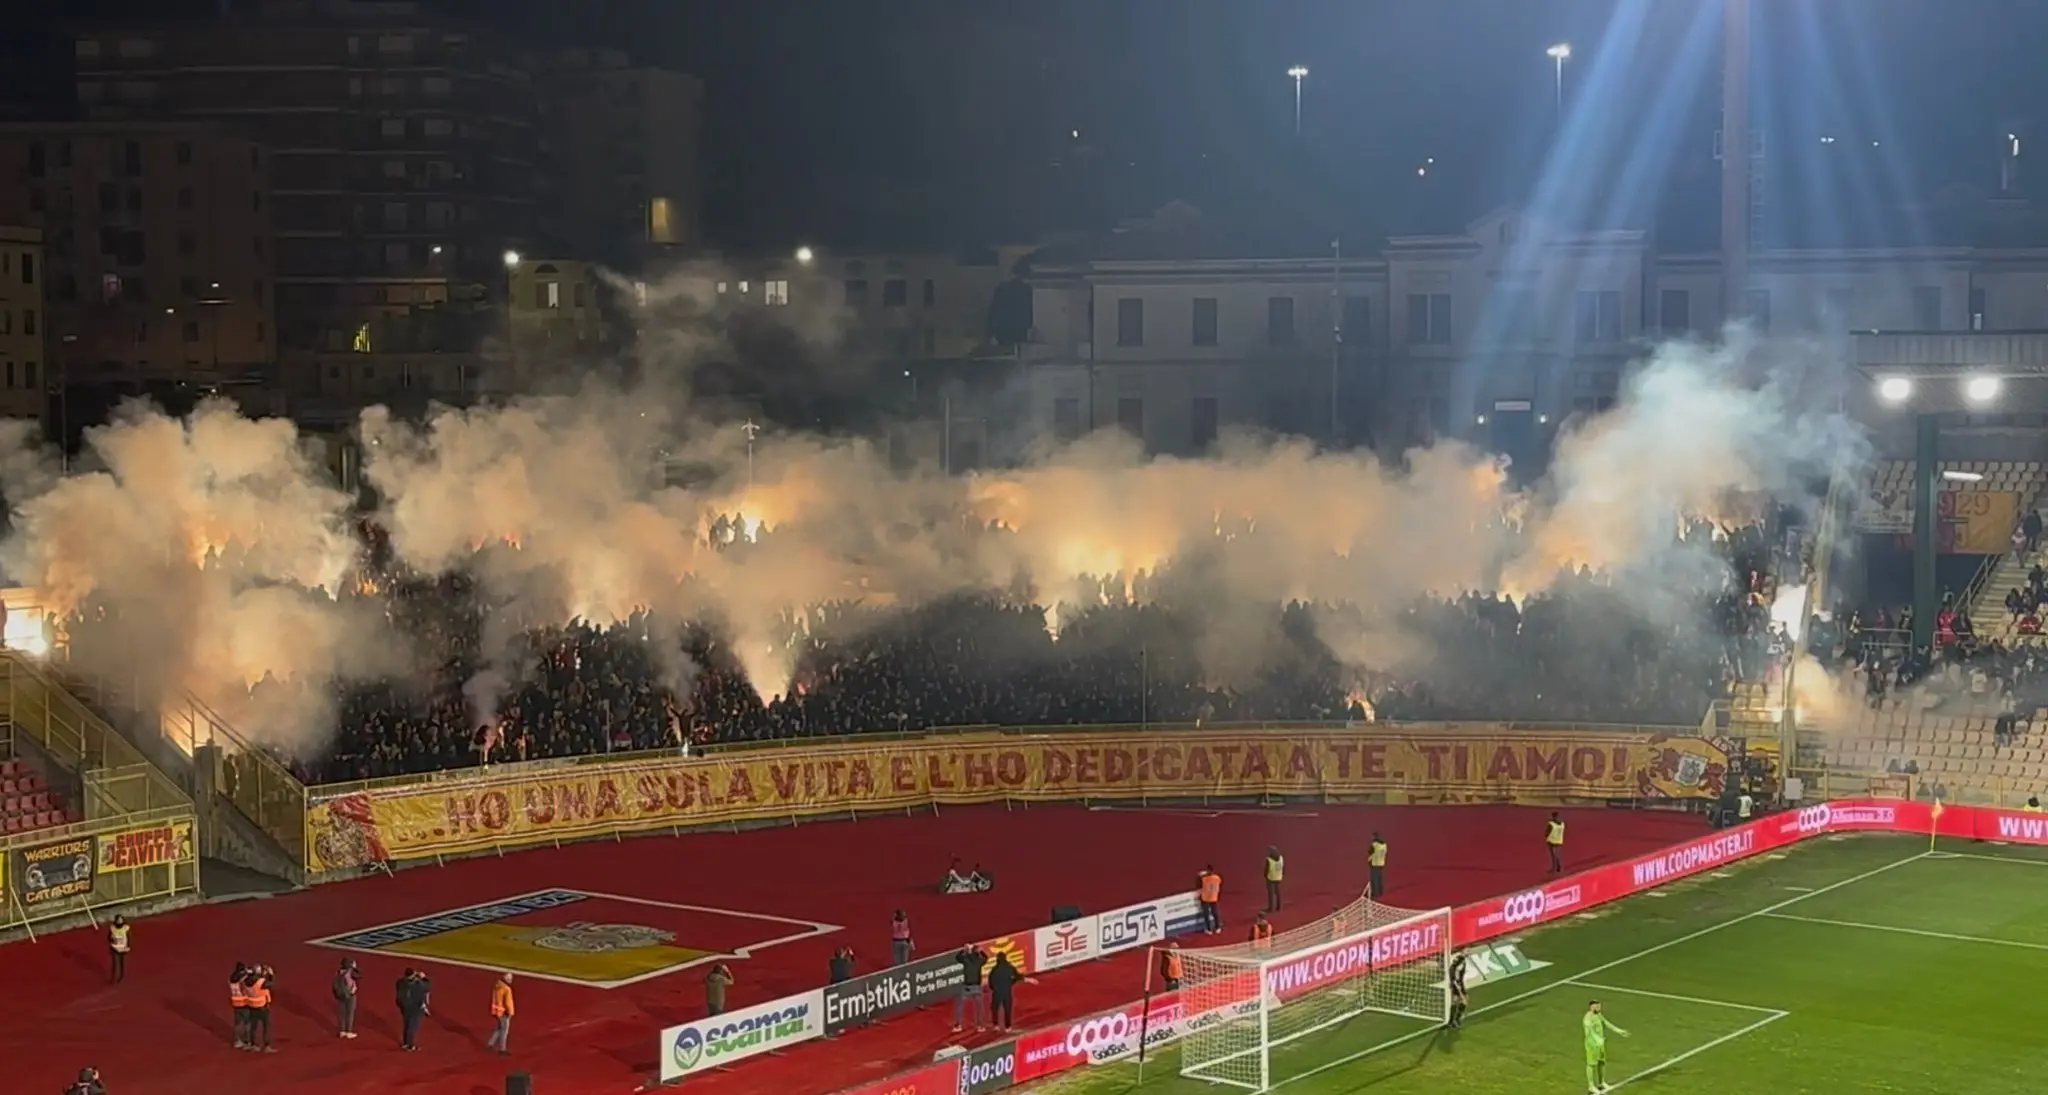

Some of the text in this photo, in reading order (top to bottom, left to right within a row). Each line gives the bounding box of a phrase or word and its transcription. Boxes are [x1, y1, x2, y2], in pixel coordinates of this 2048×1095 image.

[768, 758, 875, 799] VITA
[890, 757, 916, 791] E
[929, 752, 1026, 788] L'HO
[1042, 744, 1271, 784] DEDICATA
[1286, 743, 1318, 779] A
[1330, 743, 1405, 780] TE.
[1420, 743, 1470, 780] TI
[1486, 743, 1628, 783] AMO!
[115, 828, 173, 848] GRUPPO
[1999, 815, 2048, 838] WW
[24, 840, 90, 862] WARRIORS
[1633, 829, 1755, 885] WWW.COOPMASTER.IT
[1266, 922, 1439, 993] WWW.COOPMASTER.IT
[826, 976, 911, 1024] Ermetika
[705, 1003, 808, 1057] scamar
[970, 1054, 1014, 1085] 00:00
[1026, 1043, 1065, 1063] MASTER
